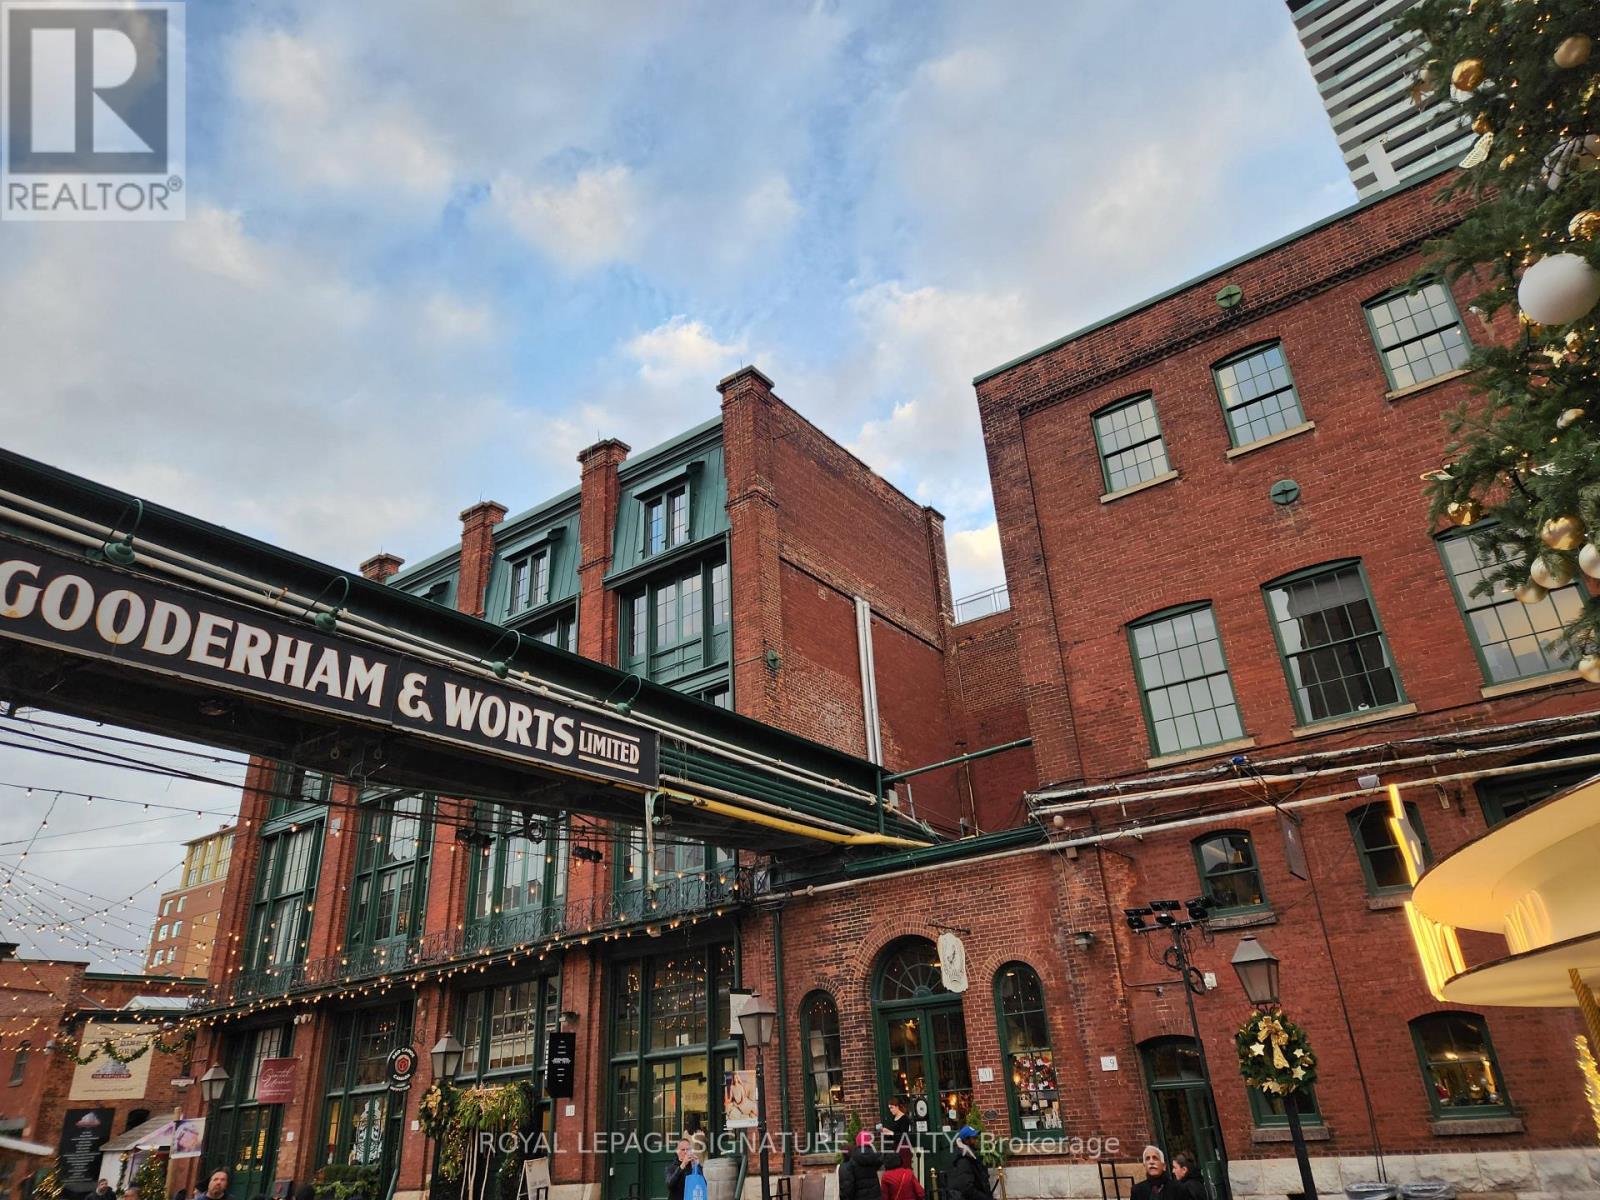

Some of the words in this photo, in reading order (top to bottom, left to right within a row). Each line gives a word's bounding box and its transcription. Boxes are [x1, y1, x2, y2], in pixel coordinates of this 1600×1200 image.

[0, 559, 388, 708] GOODERHAM
[397, 672, 434, 723] &
[443, 681, 575, 757] WORTS
[578, 729, 641, 765] LIMITED
